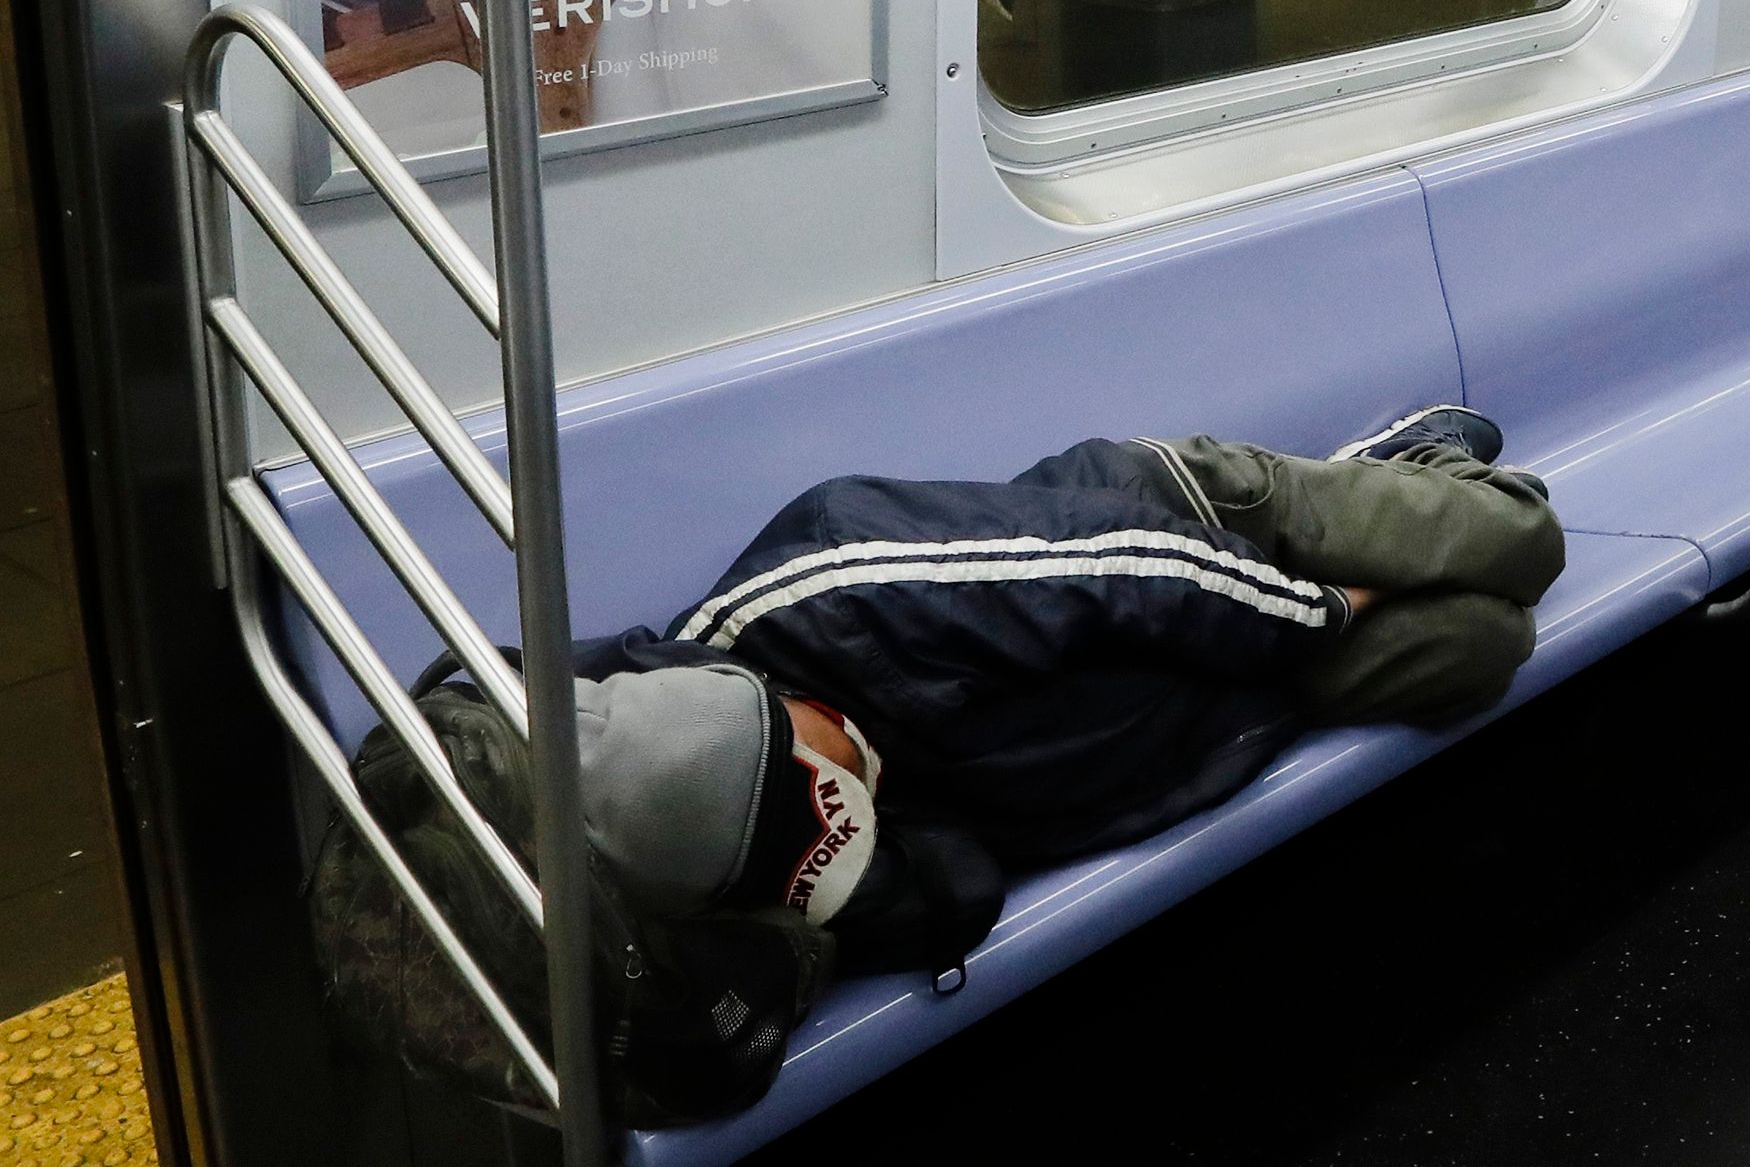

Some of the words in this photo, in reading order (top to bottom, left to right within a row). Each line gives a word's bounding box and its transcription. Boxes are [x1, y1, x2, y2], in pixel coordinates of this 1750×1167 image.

[580, 58, 634, 81] 1-Day
[639, 47, 719, 71] Shipping
[800, 816, 861, 877] YORK
[789, 878, 815, 916] EW
